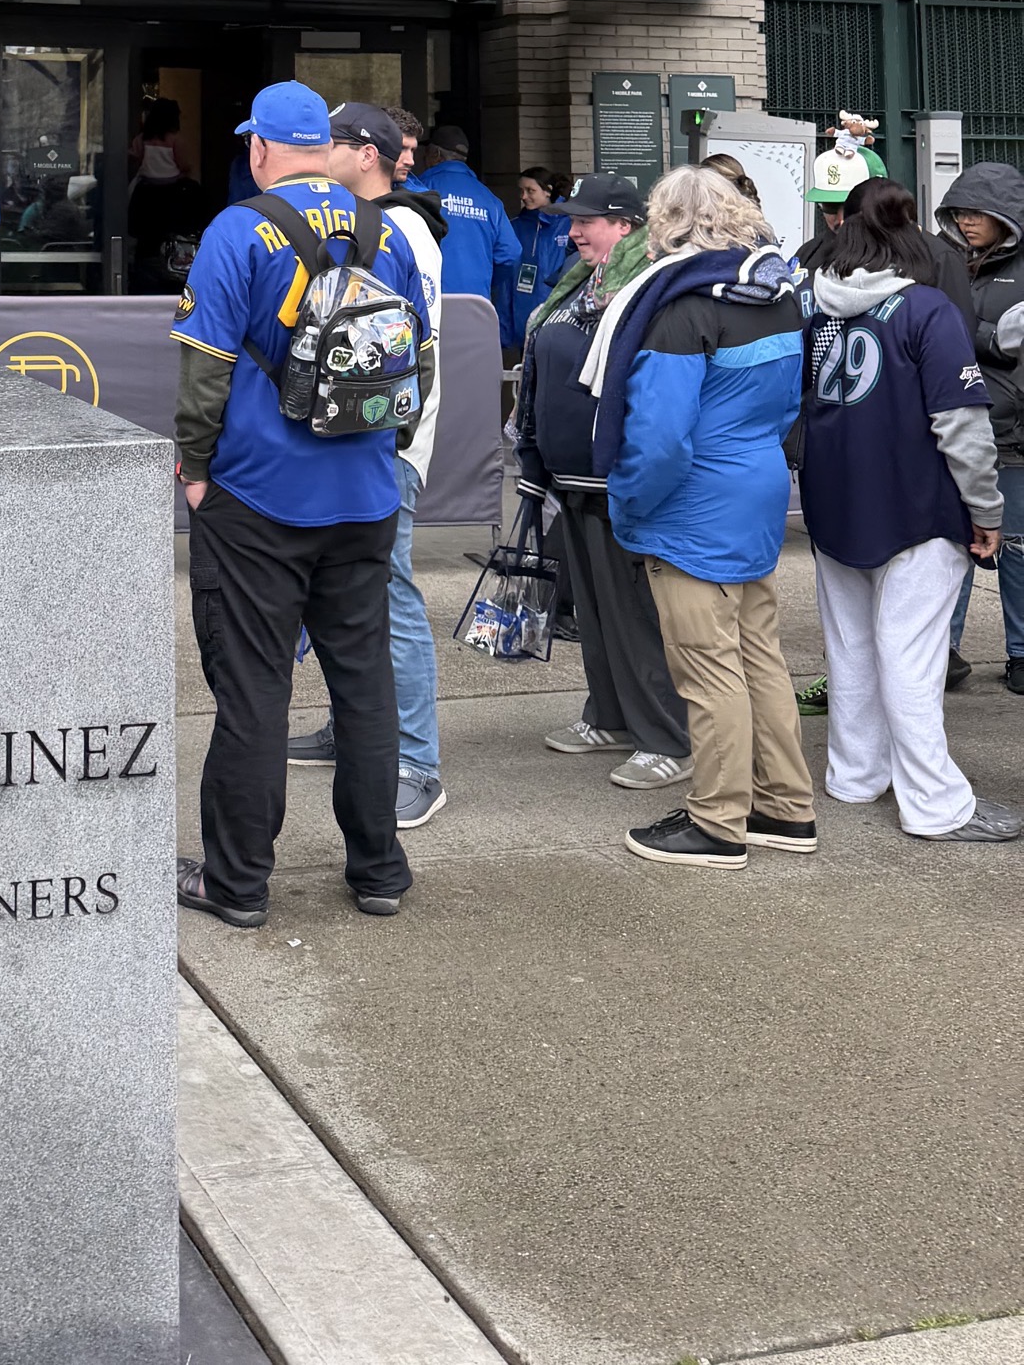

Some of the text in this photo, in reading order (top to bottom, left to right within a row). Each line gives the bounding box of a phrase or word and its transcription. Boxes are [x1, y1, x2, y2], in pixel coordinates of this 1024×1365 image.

[448, 193, 473, 206] ALLIED
[448, 199, 488, 218] UNIVERSAL
[814, 327, 883, 406] 29
